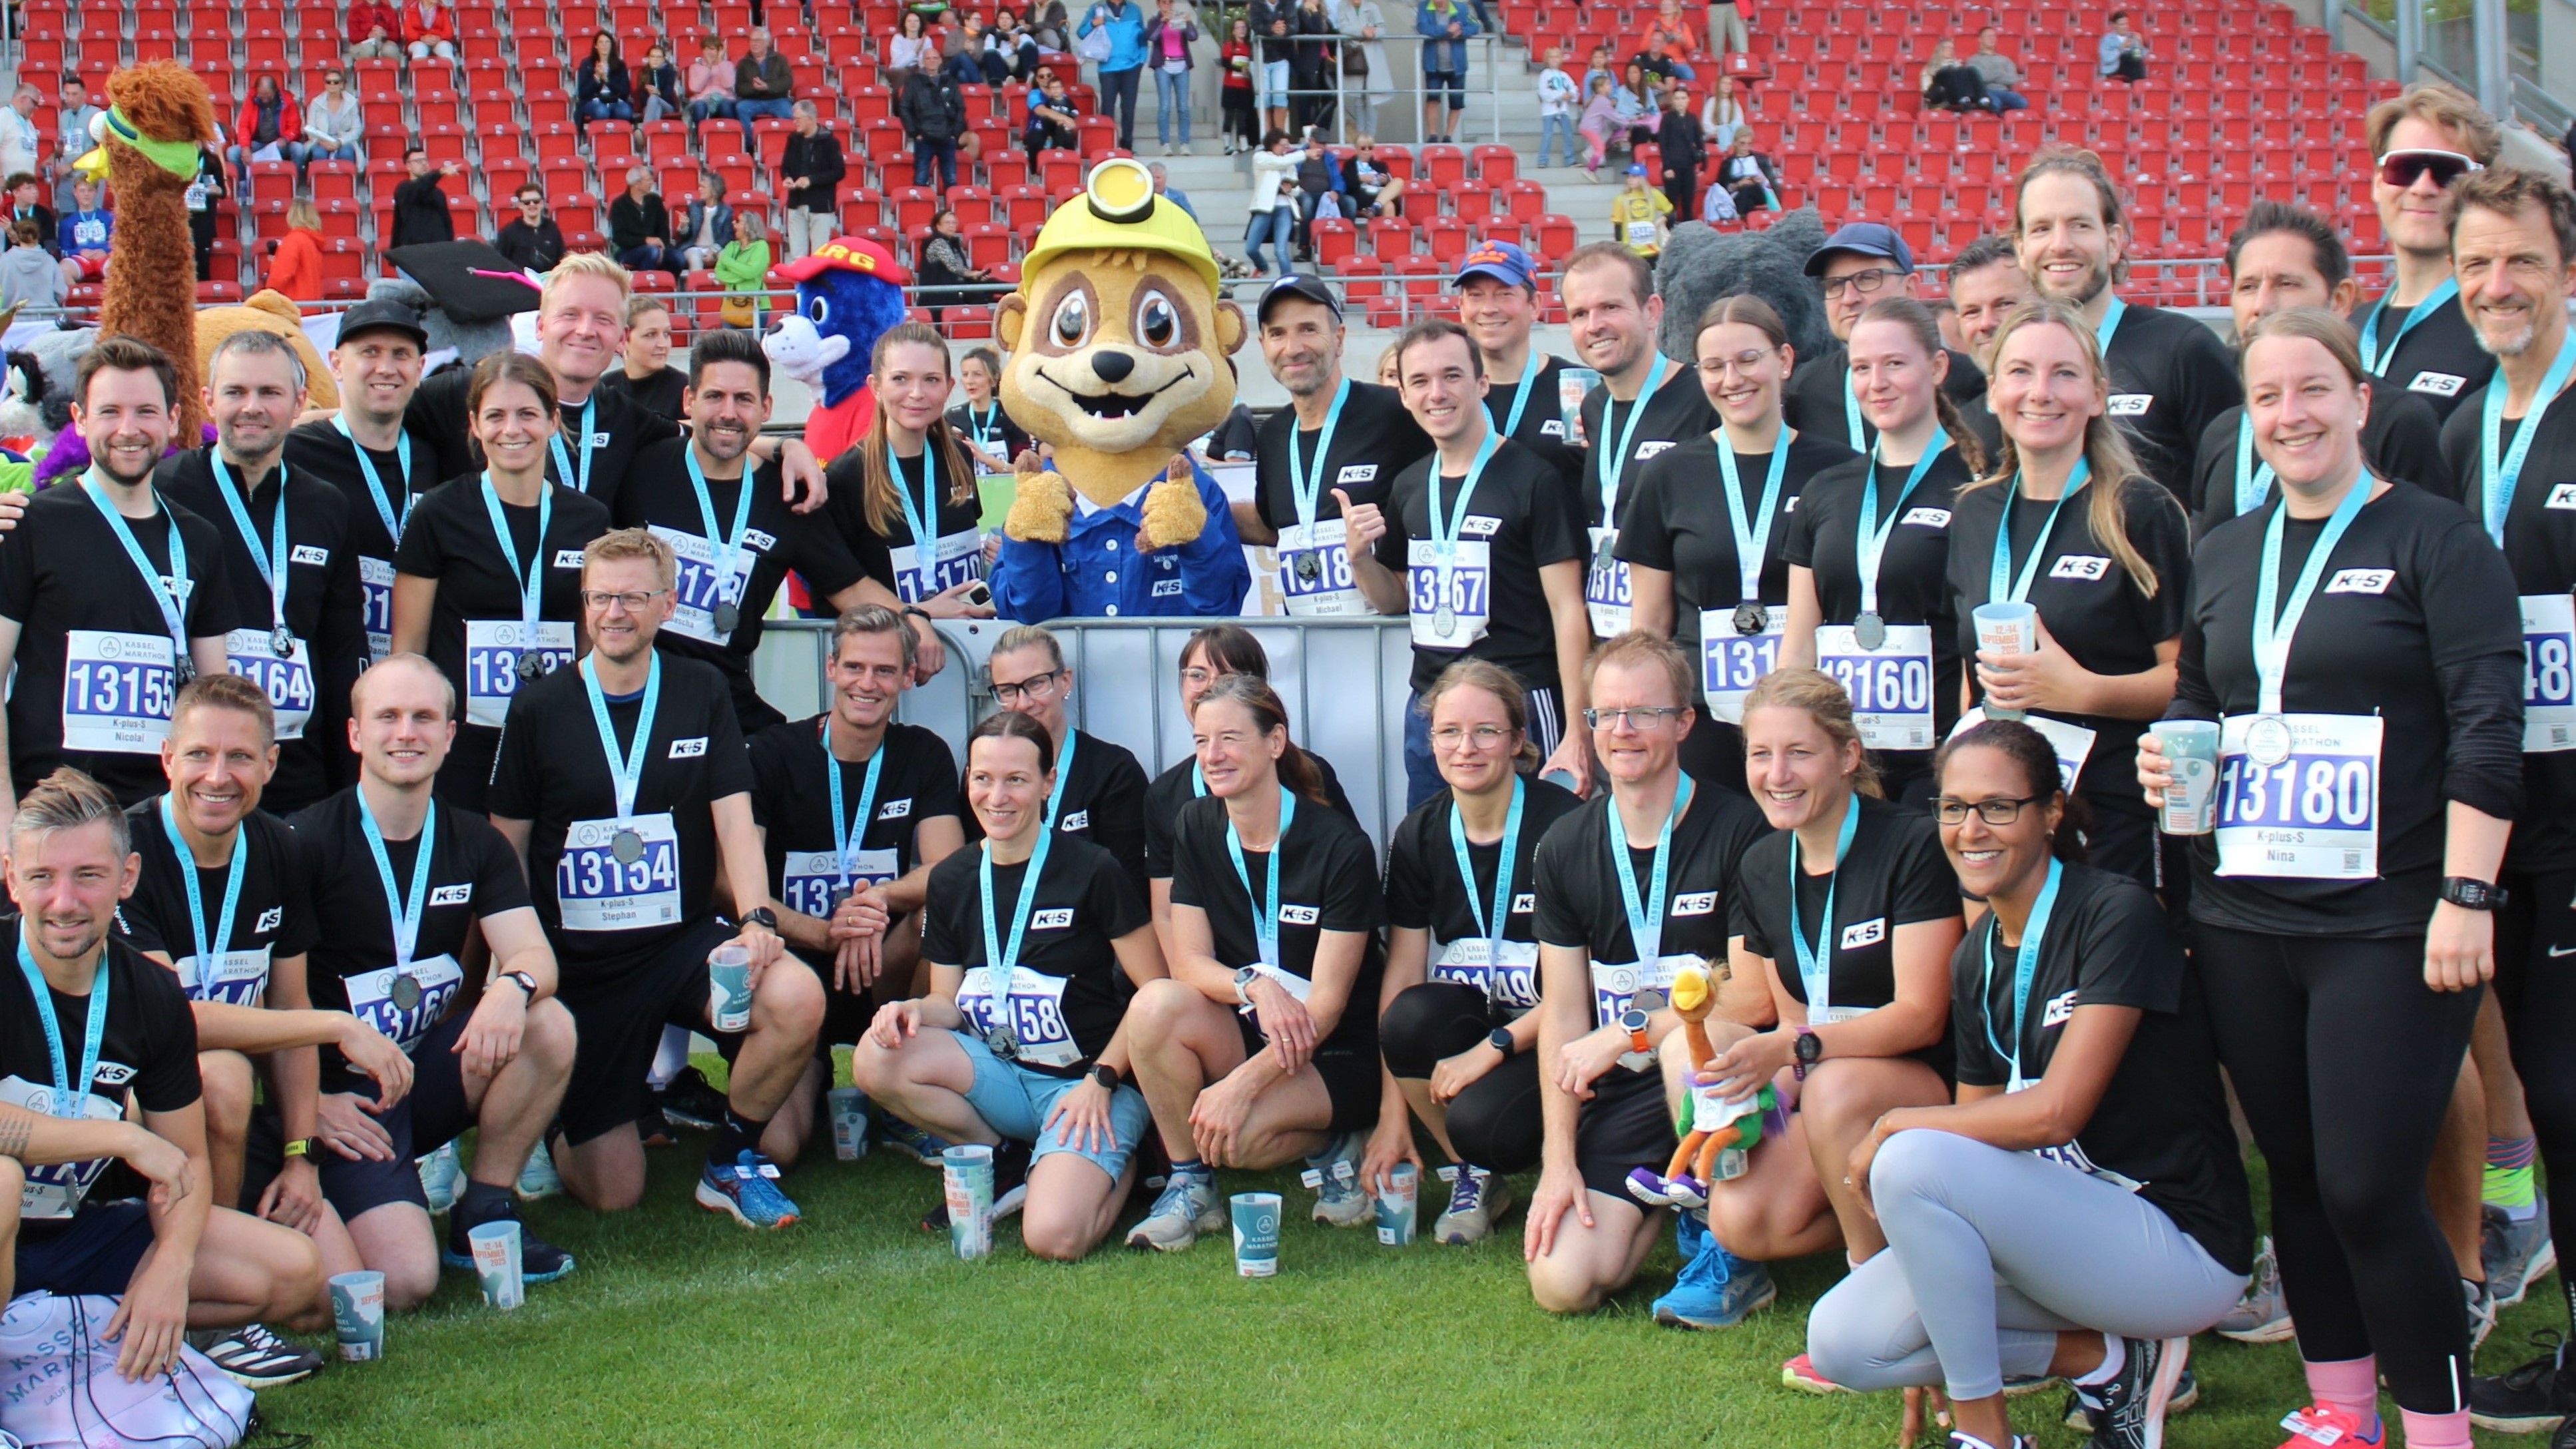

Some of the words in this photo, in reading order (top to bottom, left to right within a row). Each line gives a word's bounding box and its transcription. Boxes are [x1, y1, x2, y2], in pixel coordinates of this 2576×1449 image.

[2418, 378, 2455, 391] K+S
[2110, 398, 2145, 410] K+S
[1342, 467, 1372, 479] K+S
[1912, 511, 1943, 523] K+S
[1465, 519, 1495, 531] K+S
[692, 541, 710, 551] KASS
[746, 533, 771, 547] K+S
[937, 540, 957, 549] ASSEL
[296, 548, 324, 562] K+S
[1280, 546, 1350, 593] 118
[2059, 561, 2101, 575] K+S
[900, 553, 981, 603] 1170
[1590, 558, 1633, 603] 1313
[2336, 575, 2381, 588] K+S
[1157, 581, 1181, 593] K+S
[1408, 569, 1485, 615] 1367
[1314, 593, 1340, 603] K-plus-S
[1316, 604, 1342, 613] Michael
[125, 641, 155, 651] KASSEL
[247, 636, 272, 645] KASS
[1981, 634, 2020, 644] SEPTEMBER
[125, 651, 166, 660] MARATHON
[369, 646, 389, 656] Danie
[2001, 645, 2020, 655] 2025
[1708, 639, 1776, 687] 131
[2525, 638, 2571, 701] 48
[71, 664, 174, 717] 13155
[113, 719, 146, 729] K-plus-S
[1856, 715, 1881, 724] plus-S
[115, 731, 144, 742] Nicolai
[633, 711, 649, 750] MARATHON
[603, 722, 619, 761] MARATHON
[674, 741, 702, 754] K+S
[2293, 738, 2341, 746] RATHON
[2222, 759, 2369, 826] 13180
[881, 802, 907, 815] K+S
[2258, 830, 2304, 843] K-plus-S
[2267, 850, 2295, 862] Nina
[370, 830, 387, 860] KASSEL
[382, 860, 397, 905] MARATHON
[561, 844, 674, 895] 13154
[1616, 832, 1629, 866] KASSEL
[1624, 866, 1639, 914] MARATHON
[182, 852, 196, 886] KASSEL
[191, 886, 203, 931] MARATHON
[407, 894, 417, 921] KASSEL
[414, 850, 427, 893] MARATHON
[1495, 899, 1503, 928] KASSEL
[1499, 854, 1510, 895] MARATHON
[1649, 892, 1661, 926] KASSEL
[1655, 844, 1666, 891] MARATHON
[436, 888, 469, 902] K+S
[601, 898, 634, 908] K-plus-S
[1678, 897, 1710, 910] K+S
[216, 922, 227, 954] KASSEL
[223, 874, 238, 920] MARATHON
[602, 910, 636, 922] Stephan
[1037, 912, 1069, 924] K+S
[1284, 908, 1313, 922] K+S
[987, 912, 997, 955] MARATHON
[1002, 944, 1014, 974] KASSEL
[1010, 900, 1026, 944] MARATHON
[1846, 924, 1879, 943] K+S
[1819, 942, 1828, 974] KASSEL
[2023, 938, 2037, 978] KASSEL
[410, 967, 429, 976] SSEL
[418, 972, 442, 984] ATHON
[1438, 970, 1541, 1007] 149
[961, 998, 1063, 1042] 13158
[43, 1014, 58, 1065] MARATHON
[86, 1009, 100, 1063] MARATHON
[95, 1065, 129, 1080] K+S
[53, 1066, 66, 1103] KASSEL
[81, 1065, 92, 1102] KASSEL
[491, 1258, 507, 1267] 2025
[361, 1293, 384, 1305] SEPTEM
[9, 1312, 100, 1371] KASSEL
[5, 1328, 124, 1402] MARATHO
